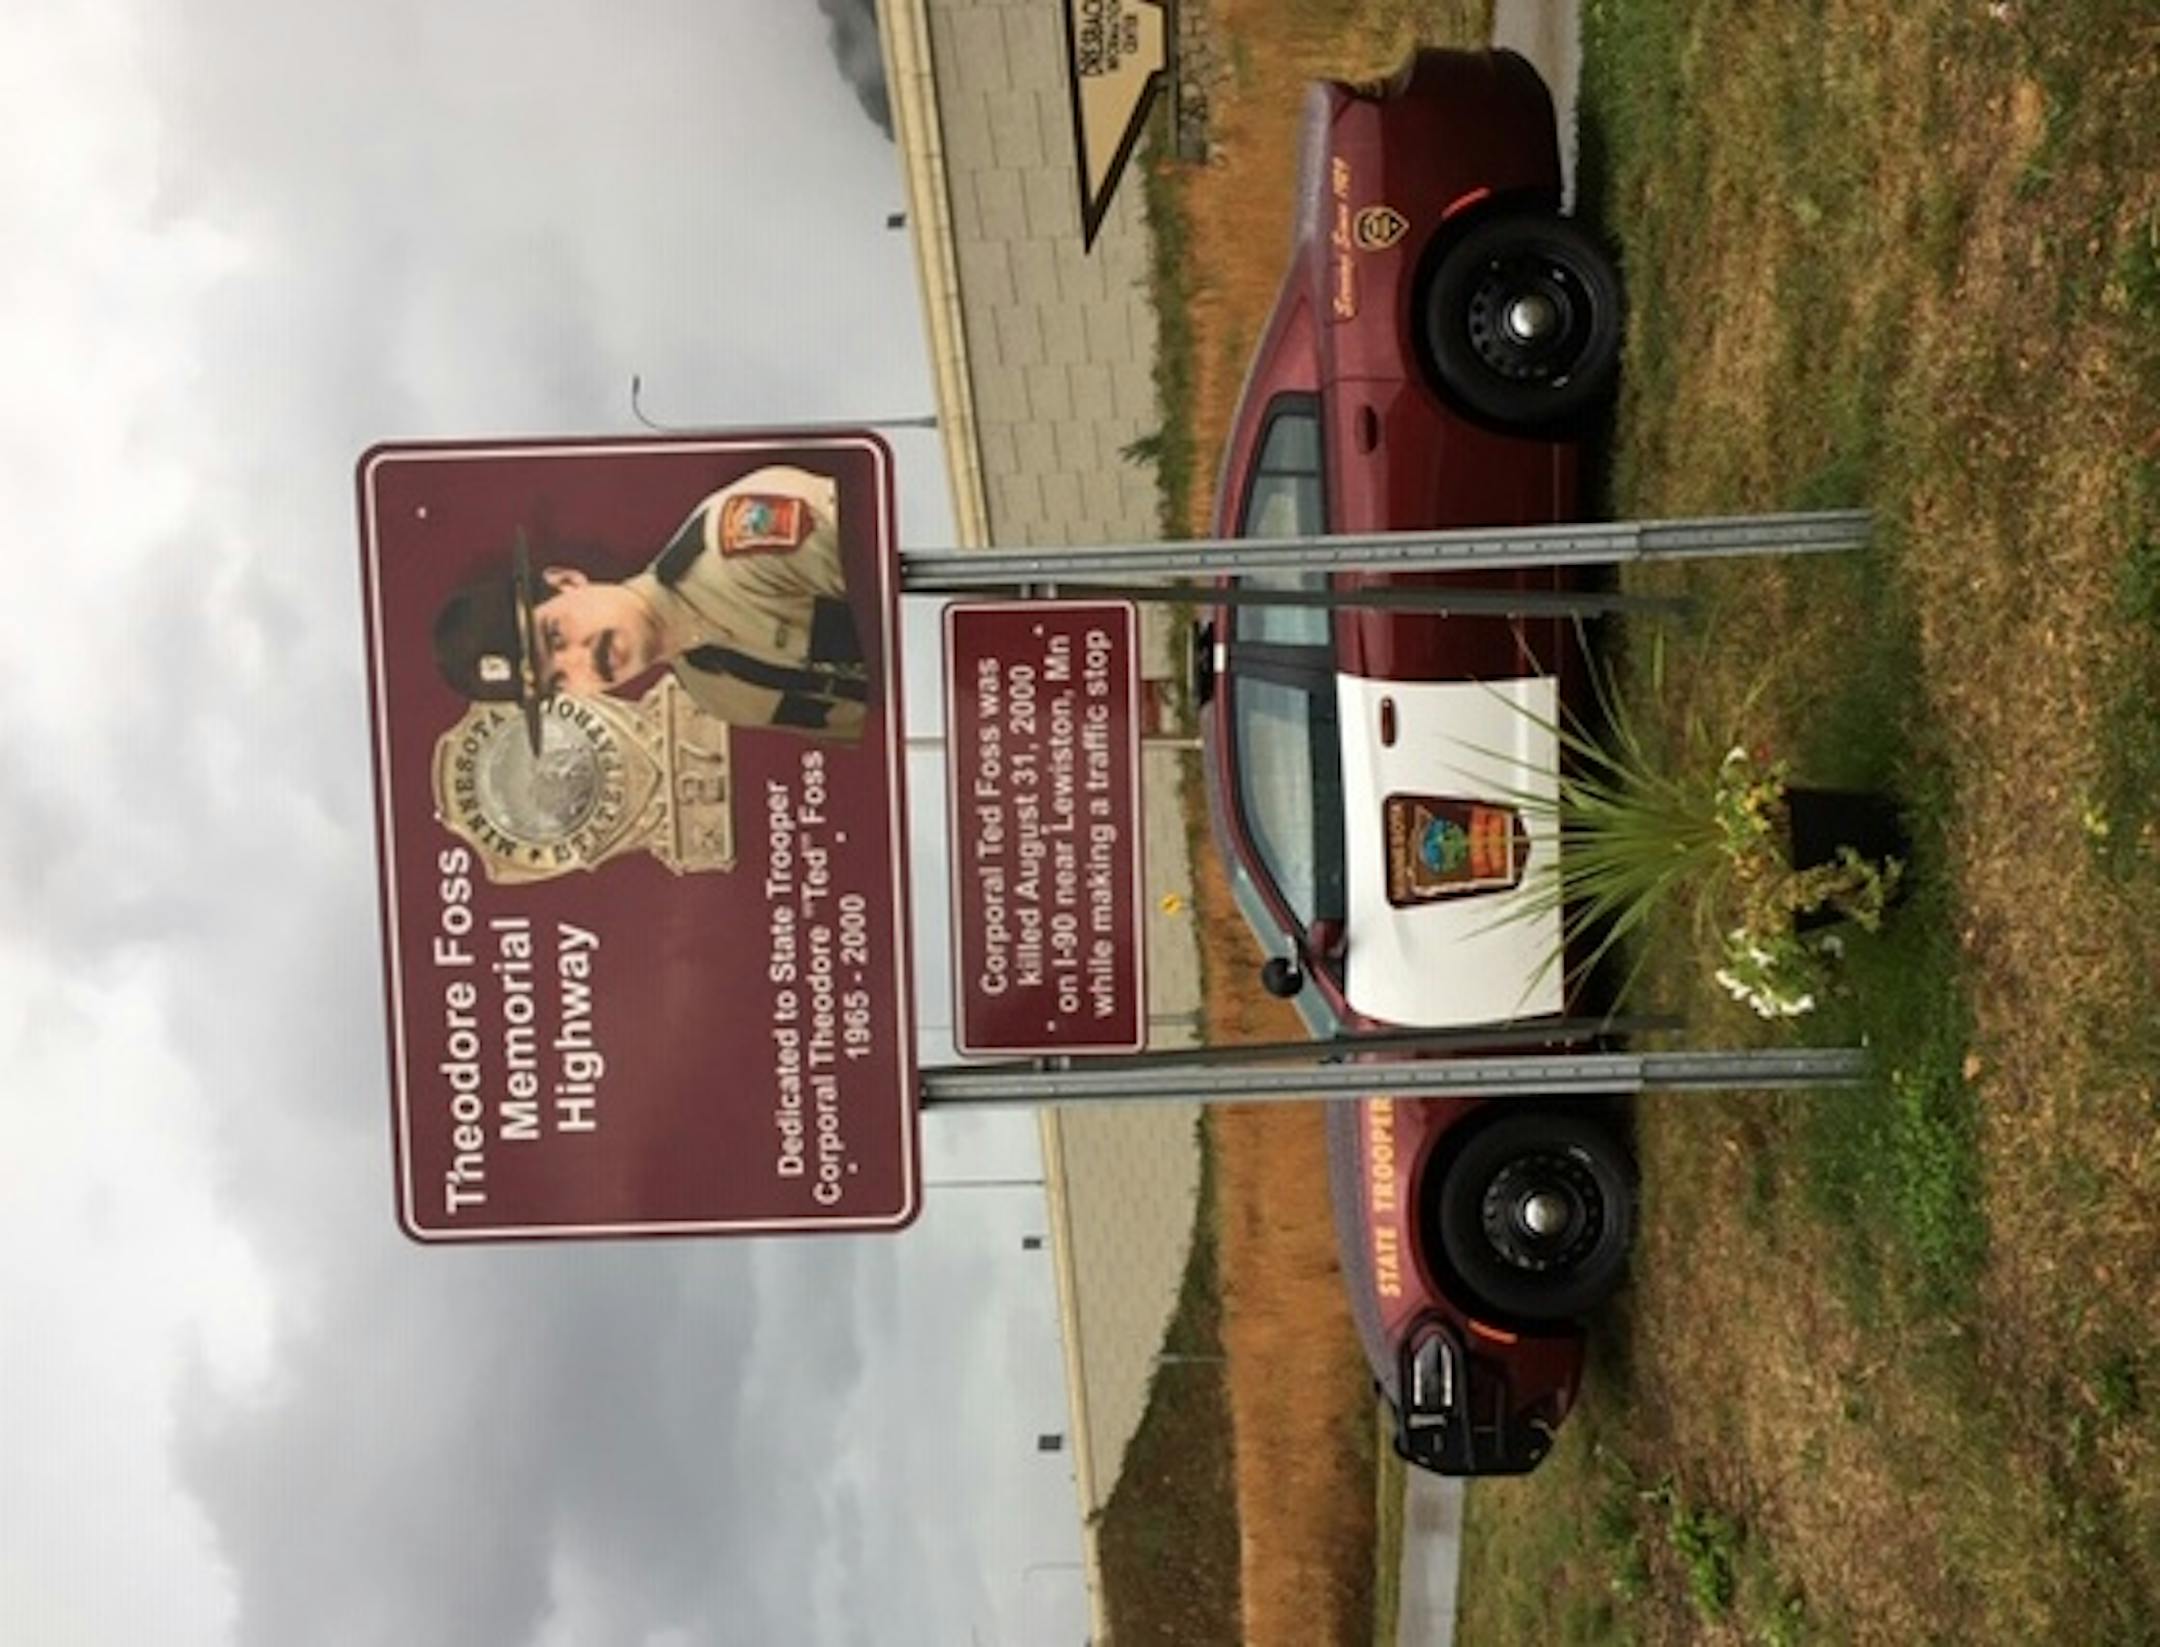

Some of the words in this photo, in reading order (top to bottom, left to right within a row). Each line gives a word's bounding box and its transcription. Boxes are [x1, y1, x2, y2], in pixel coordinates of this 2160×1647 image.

[976, 658, 1000, 718] was
[1044, 635, 1071, 681] Mn
[1083, 630, 1112, 697] stop
[1009, 665, 1037, 735] 2000
[454, 709, 516, 856] MINNESOTA
[975, 726, 1002, 797] Foss
[1010, 743, 1040, 785] 31,
[1047, 689, 1077, 833] Lewiston,
[1084, 705, 1110, 790] traffic
[799, 750, 826, 824] Foss
[1090, 798, 1110, 816] a
[554, 789, 623, 863] STATE
[765, 780, 794, 899] Trooper
[976, 806, 1004, 859] Ted
[1012, 794, 1047, 900] August
[433, 847, 475, 966] Foss
[801, 833, 829, 917] "Ted"
[1053, 841, 1077, 905] near
[1086, 824, 1117, 932] making
[769, 906, 796, 982] State
[839, 894, 869, 965] 2000
[977, 867, 1010, 994] Corporal
[1014, 909, 1044, 986] killed
[1050, 914, 1079, 966] I-90
[772, 990, 798, 1021] to
[805, 927, 836, 1066] Theodore
[1058, 975, 1079, 1013] on
[1088, 940, 1115, 1017] while
[489, 918, 540, 1140] Memorial
[553, 923, 605, 1132] Highway
[844, 990, 871, 1059] 1965
[439, 982, 487, 1213] Theodore
[774, 1030, 805, 1176] Dedicated
[808, 1075, 845, 1204] Corporal
[1369, 1096, 1397, 1213] TROOPER
[1374, 1226, 1401, 1297] STATE
